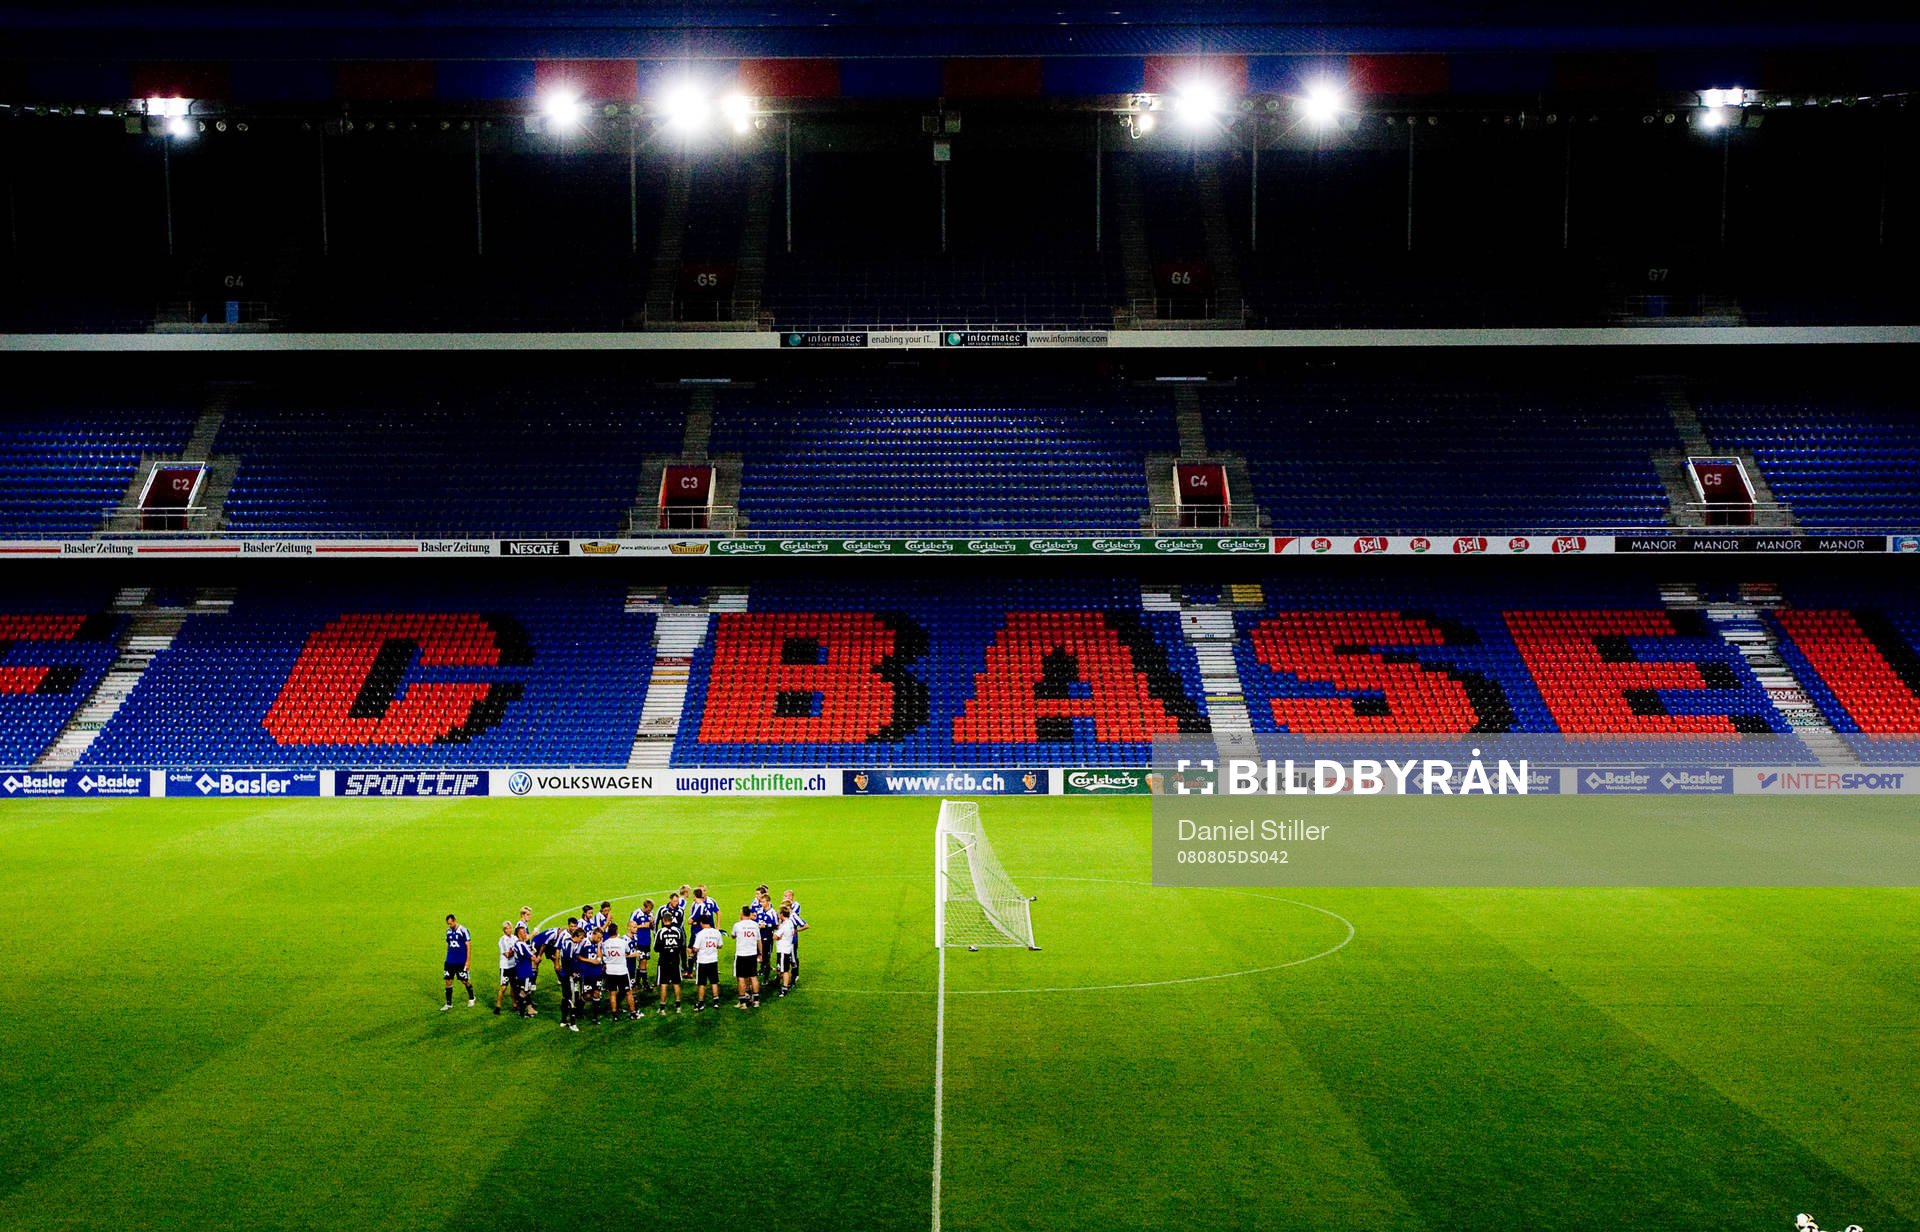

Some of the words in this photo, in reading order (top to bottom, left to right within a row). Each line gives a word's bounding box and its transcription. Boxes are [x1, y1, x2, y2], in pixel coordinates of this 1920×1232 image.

[225, 275, 244, 287] G4
[698, 273, 717, 286] G5
[1171, 272, 1191, 285] G6
[808, 334, 861, 342] informatec
[871, 333, 902, 345] enabling
[905, 336, 922, 345] your
[967, 333, 1020, 342] informatec
[1029, 332, 1108, 343] www.informatec.com
[172, 479, 190, 491] C2
[681, 477, 698, 489] C3
[1190, 475, 1208, 487] C4
[1704, 473, 1722, 486] C5
[510, 542, 560, 555] NESCAFÉ
[717, 540, 766, 554] Carlsberg
[779, 540, 828, 554] Carlsberg
[842, 540, 891, 553] Carlsberg
[905, 540, 953, 553] Carlsberg
[967, 540, 1016, 553] Carlsberg
[1029, 539, 1078, 553] Carlsberg
[1092, 539, 1141, 552] Carlsberg
[1154, 539, 1203, 552] Carlsberg
[1217, 538, 1266, 552] Carlsberg
[1314, 540, 1328, 549] Bell
[1360, 538, 1382, 552] Bell
[1413, 540, 1427, 549] Bell
[1458, 538, 1481, 552] Bell
[1512, 540, 1526, 549] Bell
[1557, 537, 1580, 551] Bell
[1631, 540, 1677, 550] MANOR
[1693, 540, 1739, 550] MANOR
[1756, 540, 1802, 550] MANOR
[1819, 540, 1865, 550] MANOR
[23, 774, 68, 788] Basler
[97, 774, 142, 788] Basler
[220, 773, 291, 794] Basler
[537, 776, 652, 790] VOLKSWAGEN
[676, 774, 826, 794] wagnerschriften.ch
[885, 773, 1005, 791] www.fcb.ch
[1068, 771, 1139, 790] Carlsberg
[1605, 771, 1650, 784] Basler
[1680, 771, 1725, 784] Basler
[1782, 773, 1905, 790] INTERSPORT
[665, 938, 678, 946] ICA
